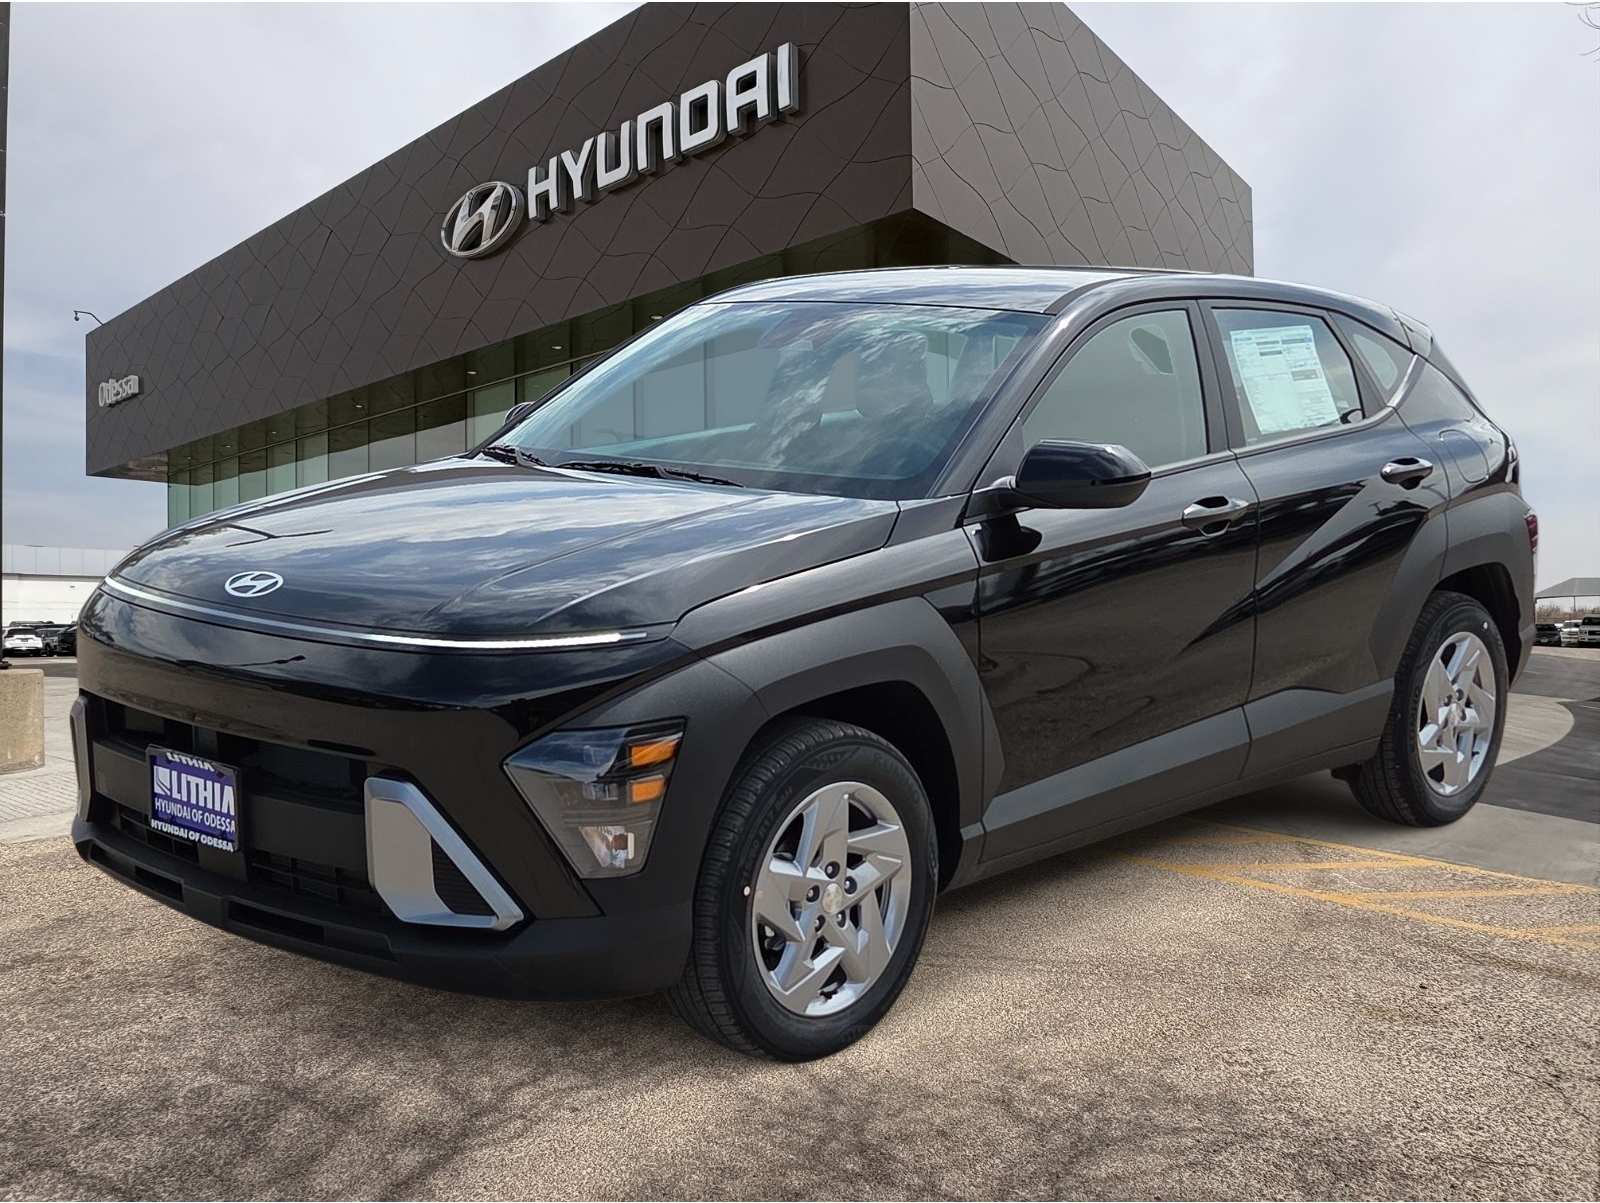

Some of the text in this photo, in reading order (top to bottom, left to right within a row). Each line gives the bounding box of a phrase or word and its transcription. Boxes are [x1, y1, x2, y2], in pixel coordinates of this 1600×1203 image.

[527, 41, 800, 221] HYUNDAI
[98, 375, 139, 407] Odessa
[171, 770, 235, 816] LITHIA
[155, 797, 236, 833] HYUNDAI OF ODESSA
[151, 819, 234, 852] HYUNDAI OF ODESSA
